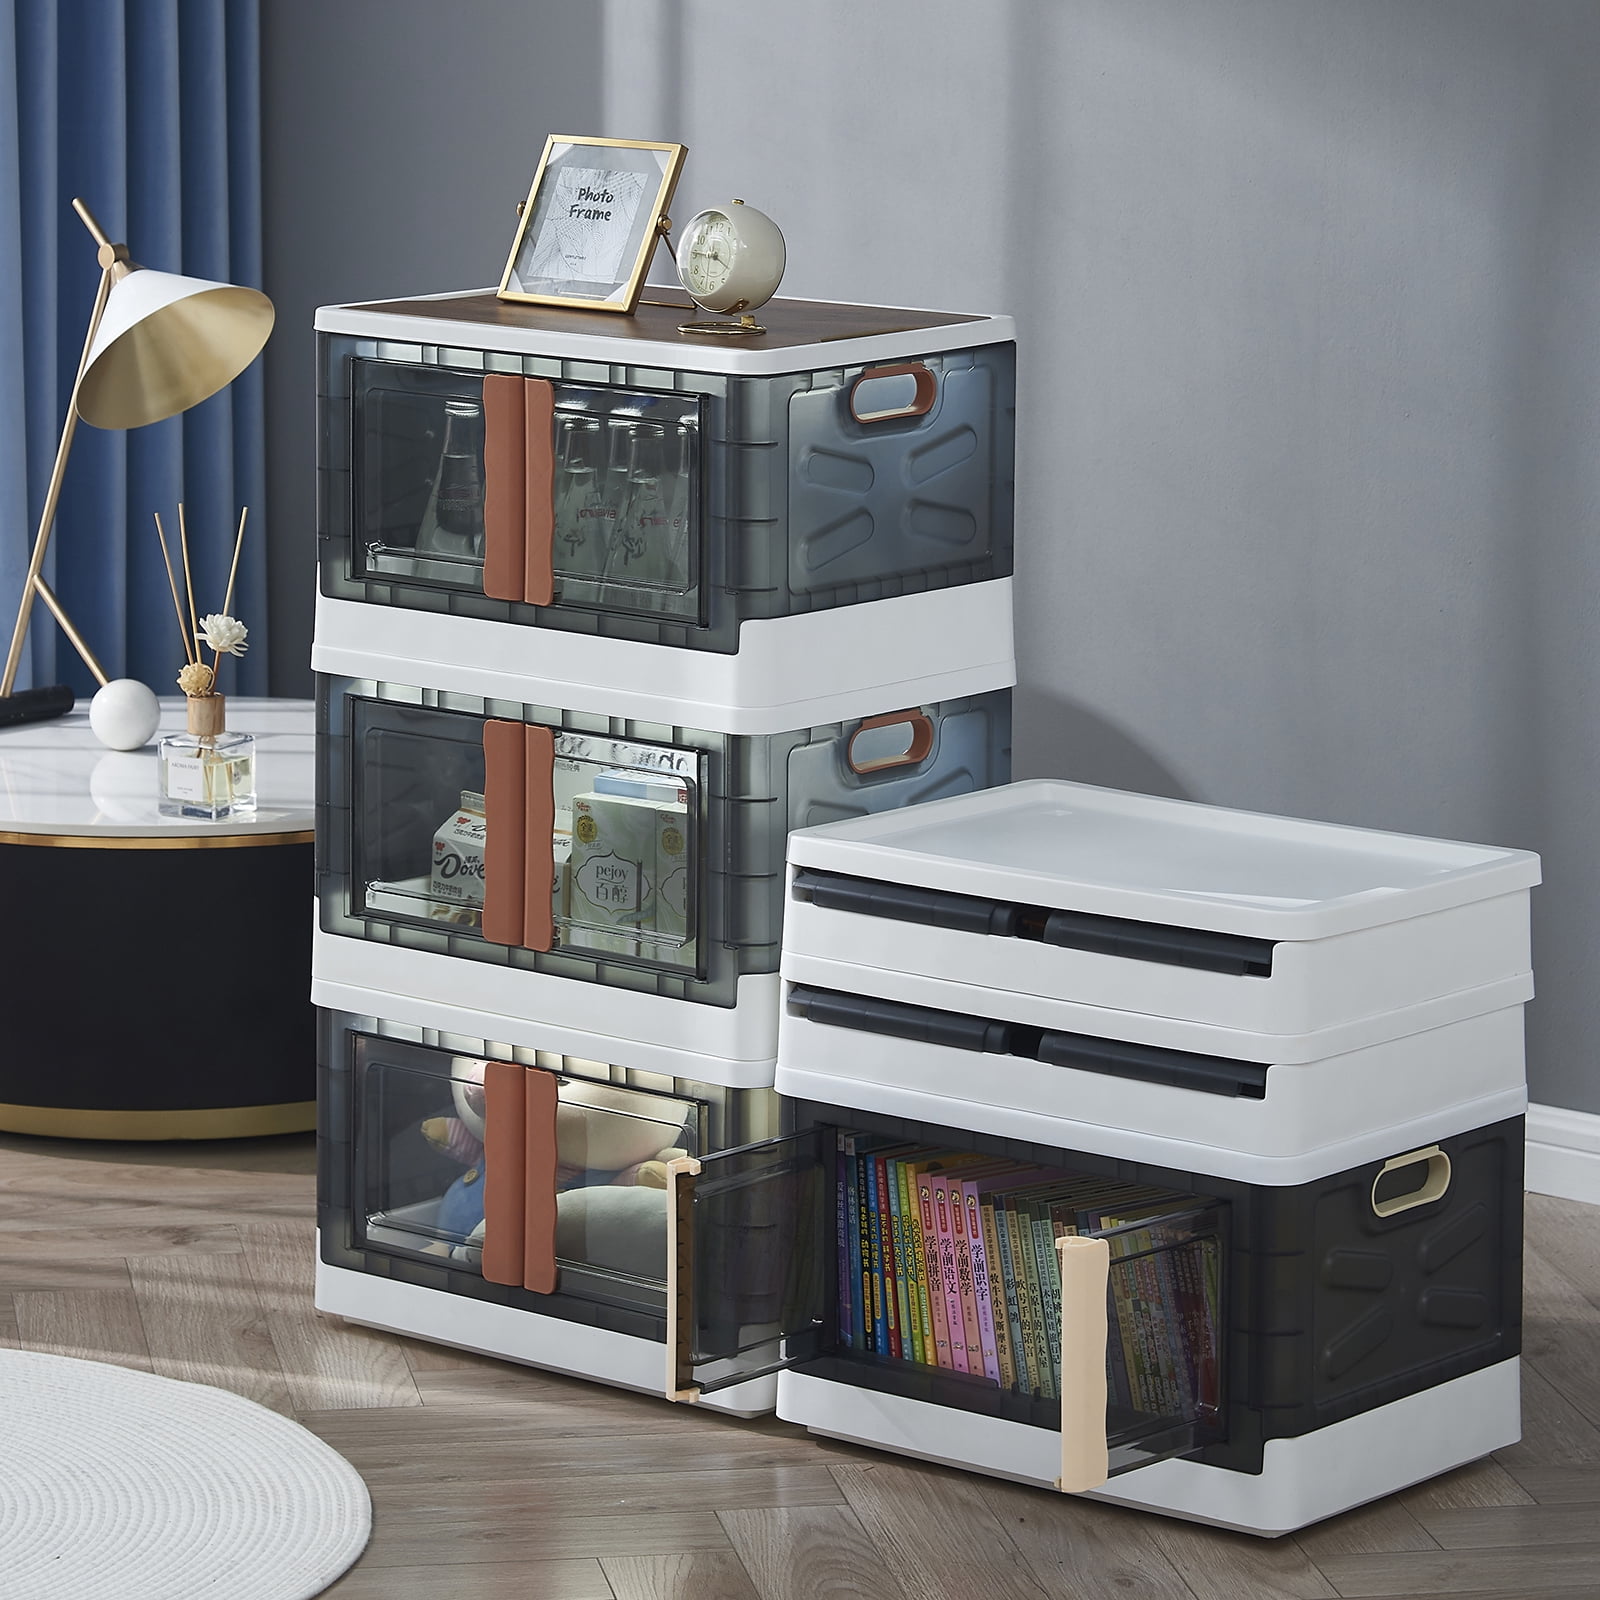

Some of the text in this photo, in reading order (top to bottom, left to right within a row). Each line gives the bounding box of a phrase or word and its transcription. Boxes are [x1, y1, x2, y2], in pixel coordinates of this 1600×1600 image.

[578, 186, 614, 203] Photo
[569, 204, 612, 221] Frame
[715, 223, 724, 232] 12
[697, 235, 706, 246] 10
[693, 265, 699, 275] 8
[700, 275, 705, 285] 7
[709, 281, 715, 291] 6
[434, 853, 485, 879] Dove
[596, 865, 629, 879] pejoy
[596, 884, 629, 904] 百醇
[925, 1234, 942, 1292] 学前拼音
[940, 1237, 958, 1295] 学前语文
[955, 1239, 973, 1297] 学前数学
[971, 1244, 988, 1301] 学前识字
[1029, 1282, 1049, 1369] 草原上的小木屋
